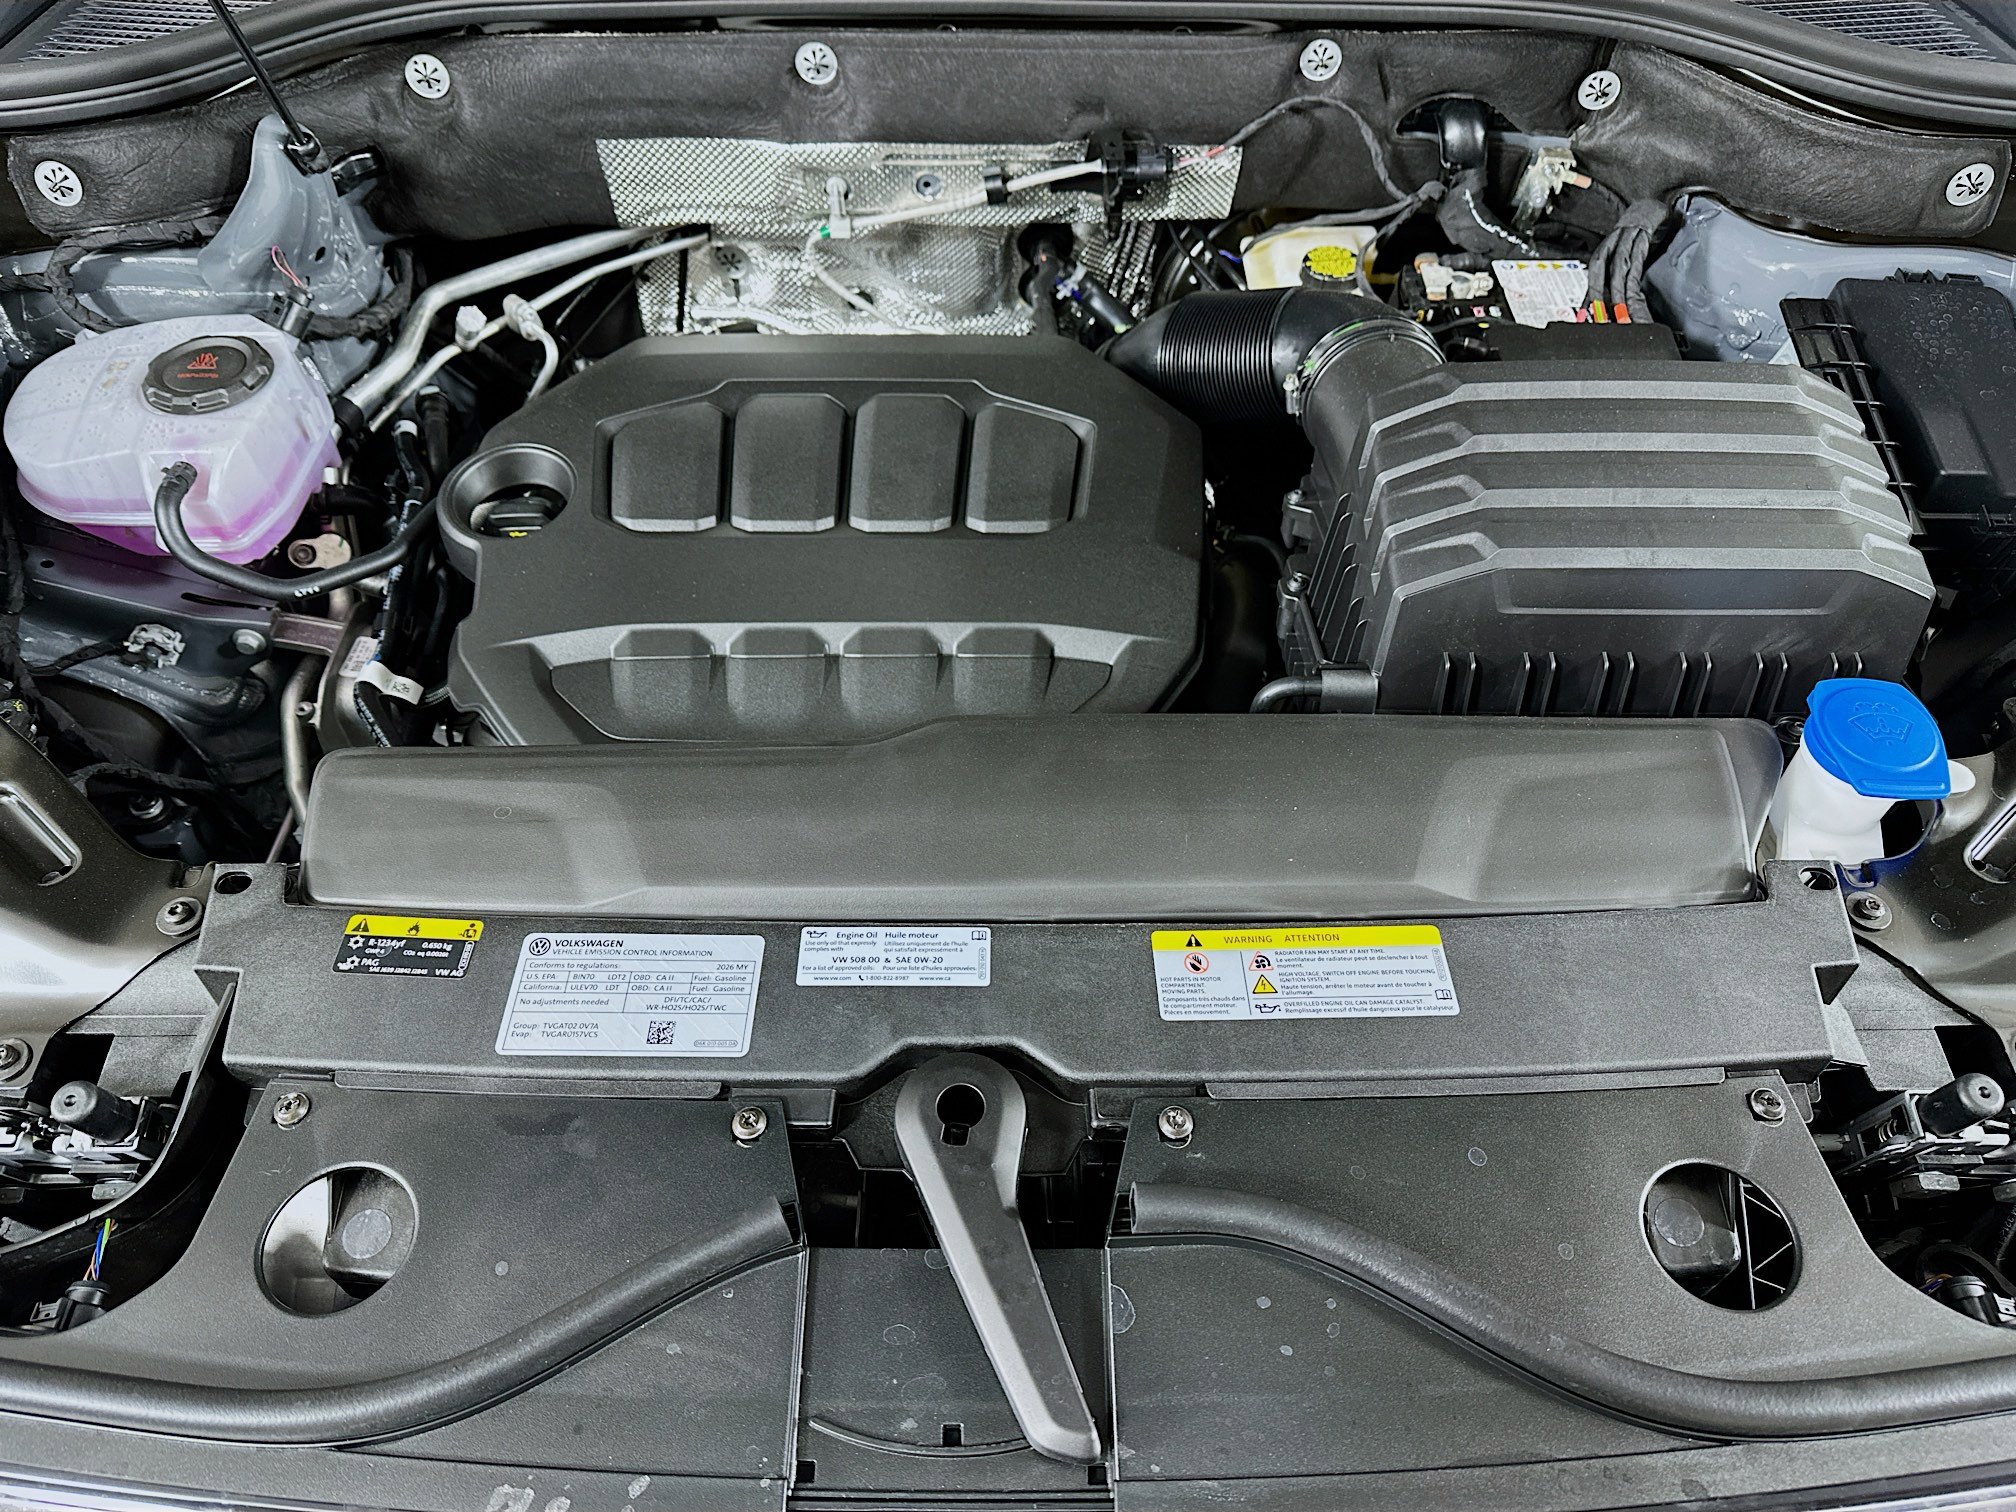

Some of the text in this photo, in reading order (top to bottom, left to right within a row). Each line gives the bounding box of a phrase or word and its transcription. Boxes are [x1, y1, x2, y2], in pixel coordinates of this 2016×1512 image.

[836, 932, 864, 940] Engine
[1224, 934, 1340, 944] WARNING ATTENTION
[368, 938, 406, 949] R-1234yf
[443, 943, 452, 951] kg
[361, 958, 380, 966] PAG
